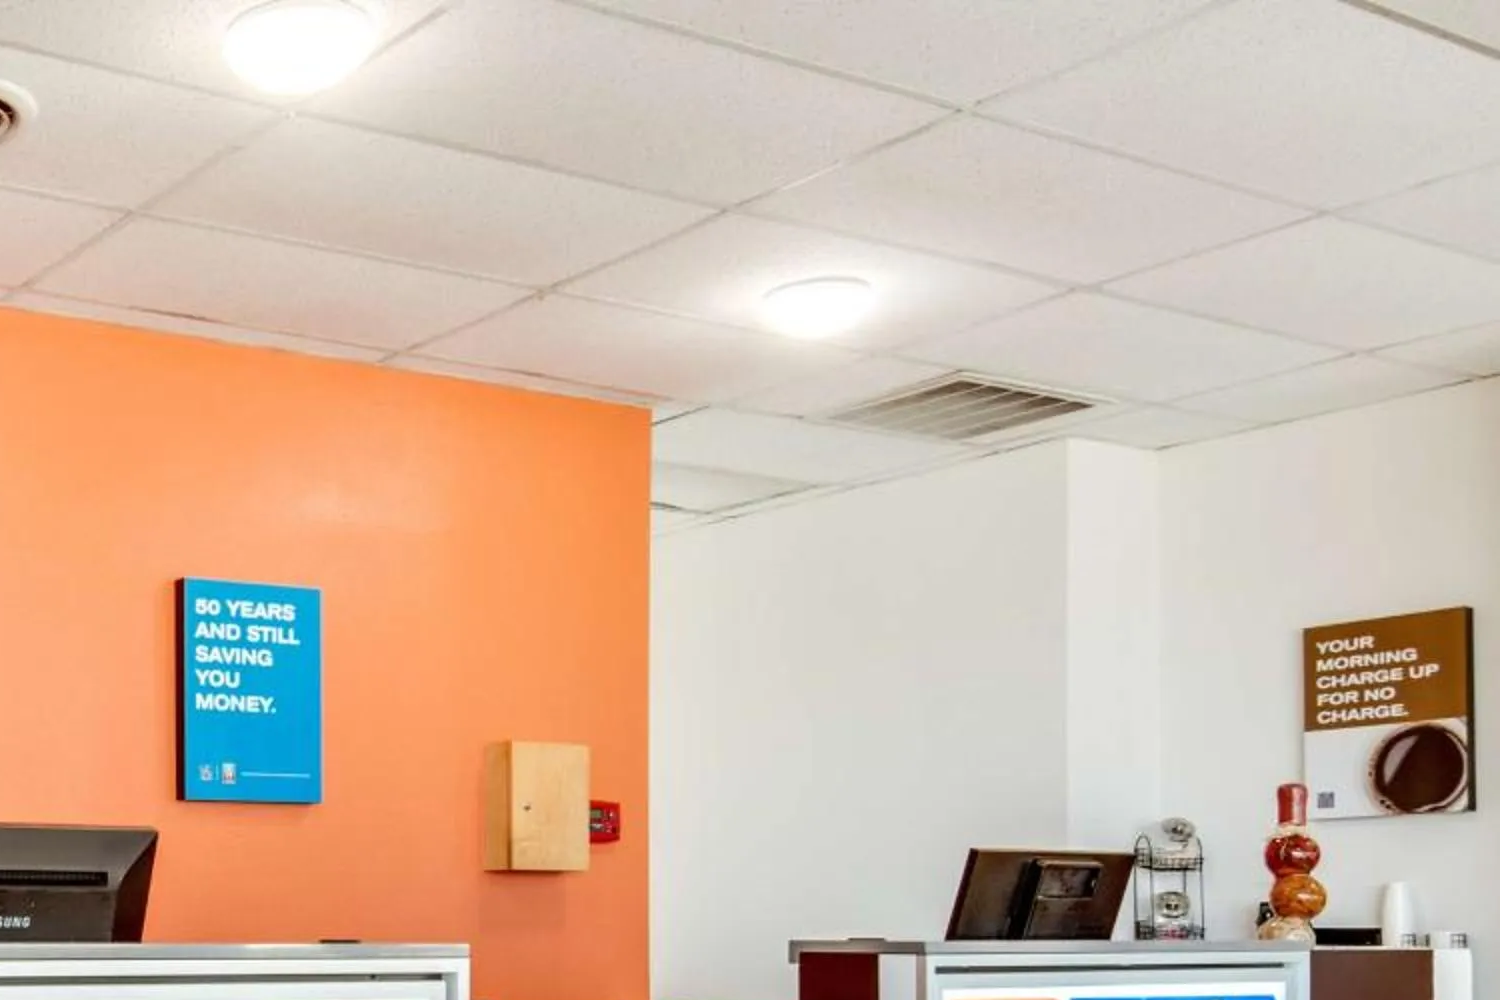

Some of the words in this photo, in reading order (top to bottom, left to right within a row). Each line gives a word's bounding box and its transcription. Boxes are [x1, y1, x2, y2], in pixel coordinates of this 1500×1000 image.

[195, 598, 221, 616] 50
[227, 600, 296, 622] YEARS
[195, 622, 241, 641] AND
[247, 626, 300, 645] STILL
[1316, 635, 1375, 655] YOUR
[195, 645, 273, 667] SAVING
[1316, 648, 1418, 672] MORNING
[195, 669, 240, 688] YOU
[1316, 667, 1404, 689] CHARGE
[1409, 663, 1440, 679] UP
[195, 693, 276, 714] MONEY.
[1317, 690, 1359, 707] FOR
[1364, 687, 1396, 701] NO
[1317, 703, 1409, 724] CHARGE.
